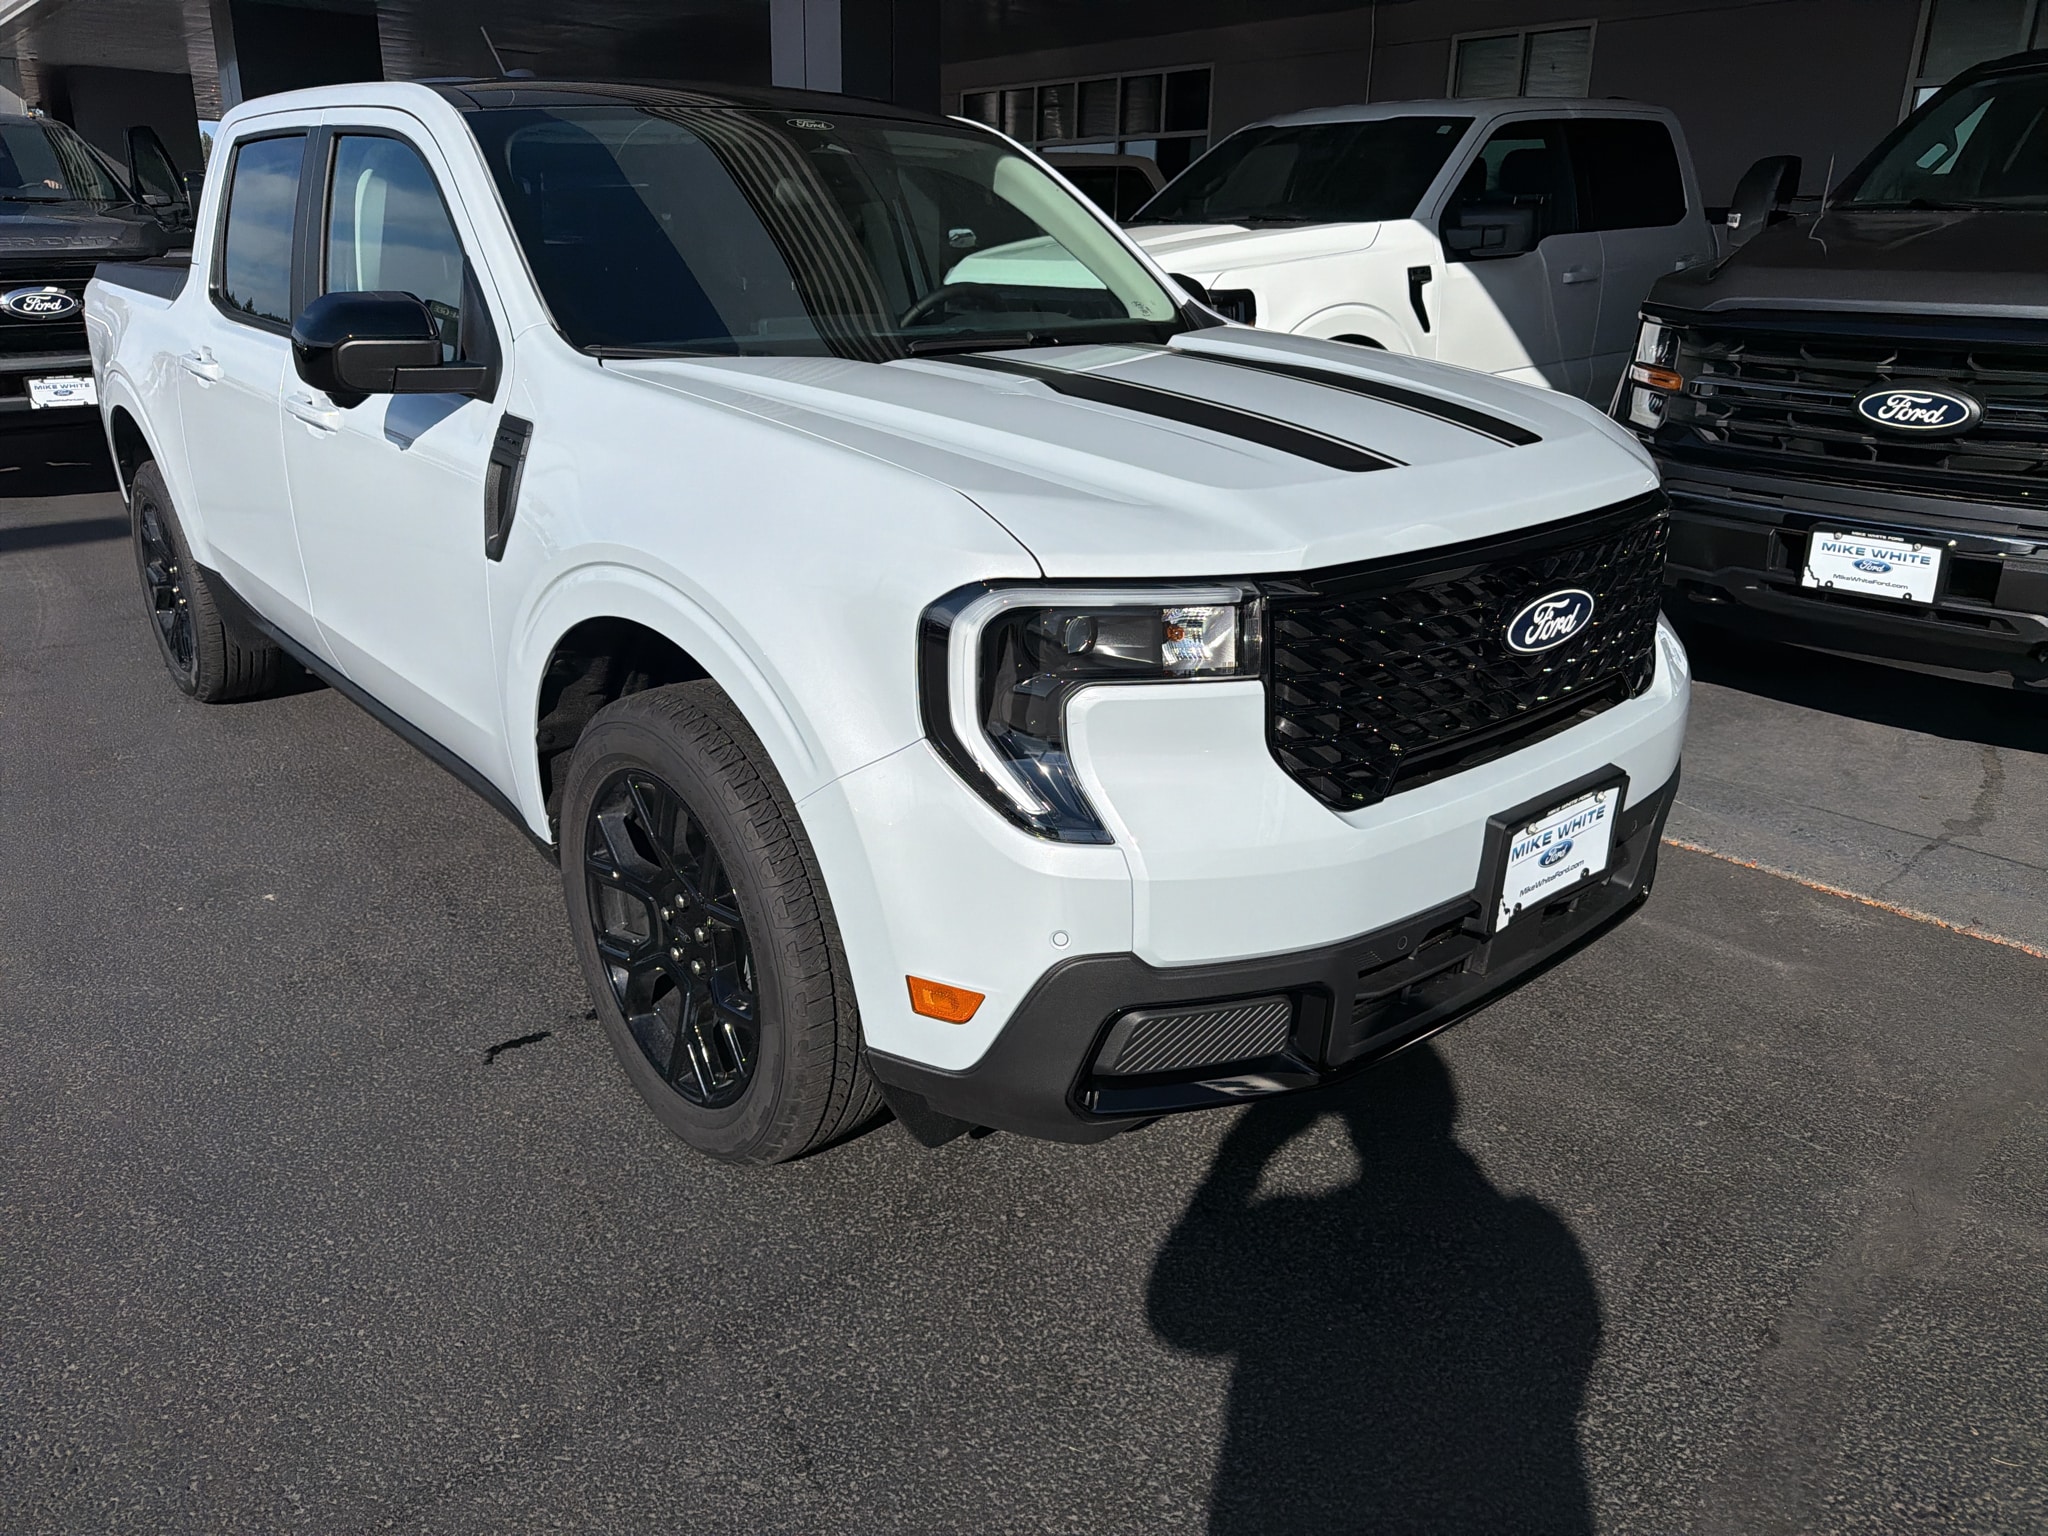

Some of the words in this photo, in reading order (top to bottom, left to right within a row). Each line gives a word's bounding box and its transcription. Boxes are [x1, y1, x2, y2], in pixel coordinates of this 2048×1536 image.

[23, 296, 62, 310] Ford
[1878, 394, 1948, 424] Ford
[1821, 542, 1866, 556] MIKE
[1871, 548, 1932, 566] WHITE
[1859, 560, 1886, 572] Ford
[1833, 574, 1908, 590] MikeWhiteFord.com
[1525, 598, 1581, 644] Ford
[1512, 830, 1552, 862] MIKE
[1558, 805, 1606, 839] WHITE
[1544, 843, 1568, 865] Ford
[1520, 860, 1584, 897] MikeWhiteFord.com
